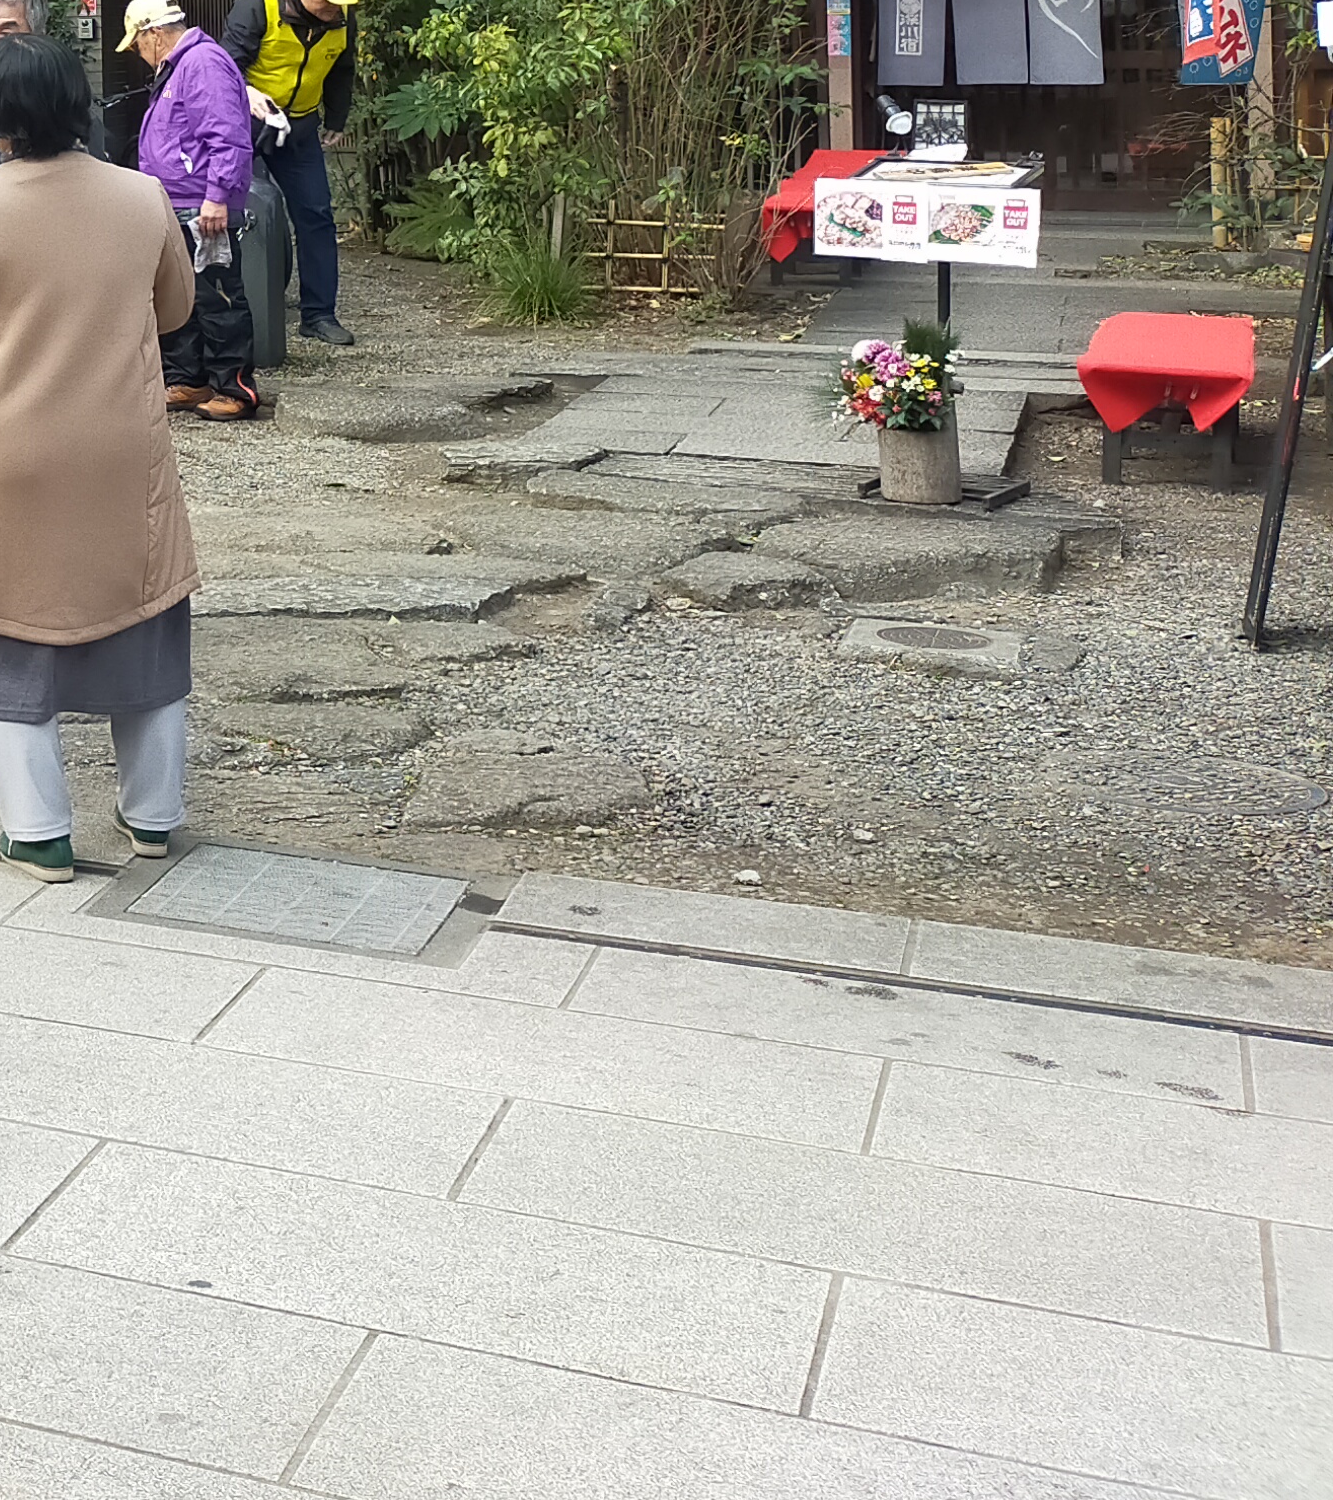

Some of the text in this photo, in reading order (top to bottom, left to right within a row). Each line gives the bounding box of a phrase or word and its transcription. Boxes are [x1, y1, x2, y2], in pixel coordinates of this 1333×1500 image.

[899, 13, 920, 53] 深川宿
[892, 204, 916, 214] TAKE
[1004, 209, 1028, 219] TAKE
[895, 213, 914, 223] OUT
[1006, 218, 1026, 227] OUT
